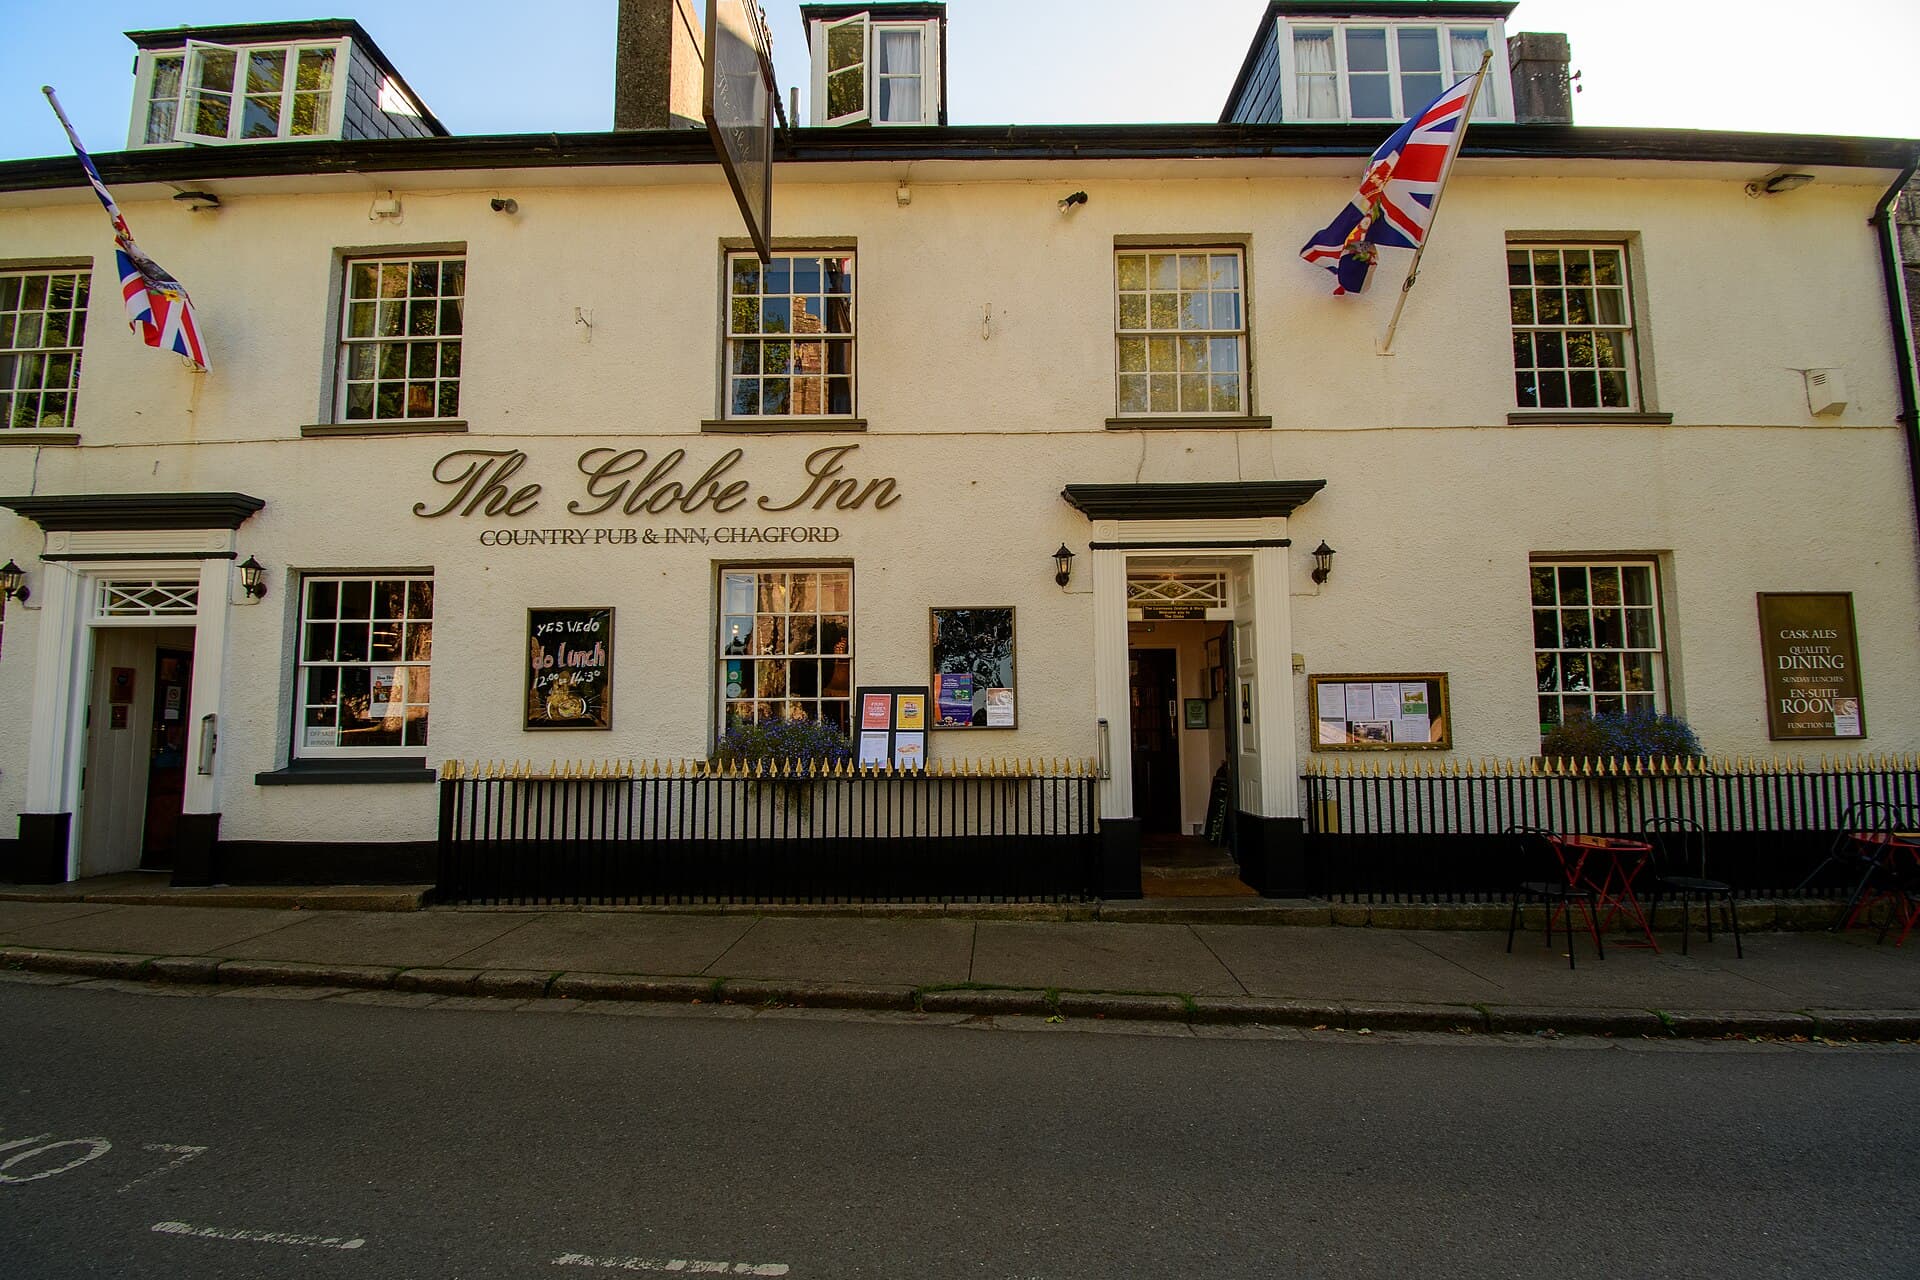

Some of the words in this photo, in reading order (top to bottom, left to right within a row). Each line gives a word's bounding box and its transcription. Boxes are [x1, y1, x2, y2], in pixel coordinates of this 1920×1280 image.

[413, 449, 542, 518] The
[567, 448, 749, 515] Globe
[757, 444, 902, 512] Inn
[480, 529, 590, 546] COUNTRY
[593, 529, 637, 545] PUB
[642, 528, 659, 544] &
[664, 527, 709, 546] INN,
[714, 526, 840, 543] CHAGFORD
[1780, 630, 1810, 639] CASK
[1812, 629, 1838, 639] ALES
[558, 641, 606, 668] Lunch
[1789, 645, 1831, 655] QUALITY
[1778, 655, 1845, 670] DINING
[1790, 688, 1840, 698] EN-SUITE
